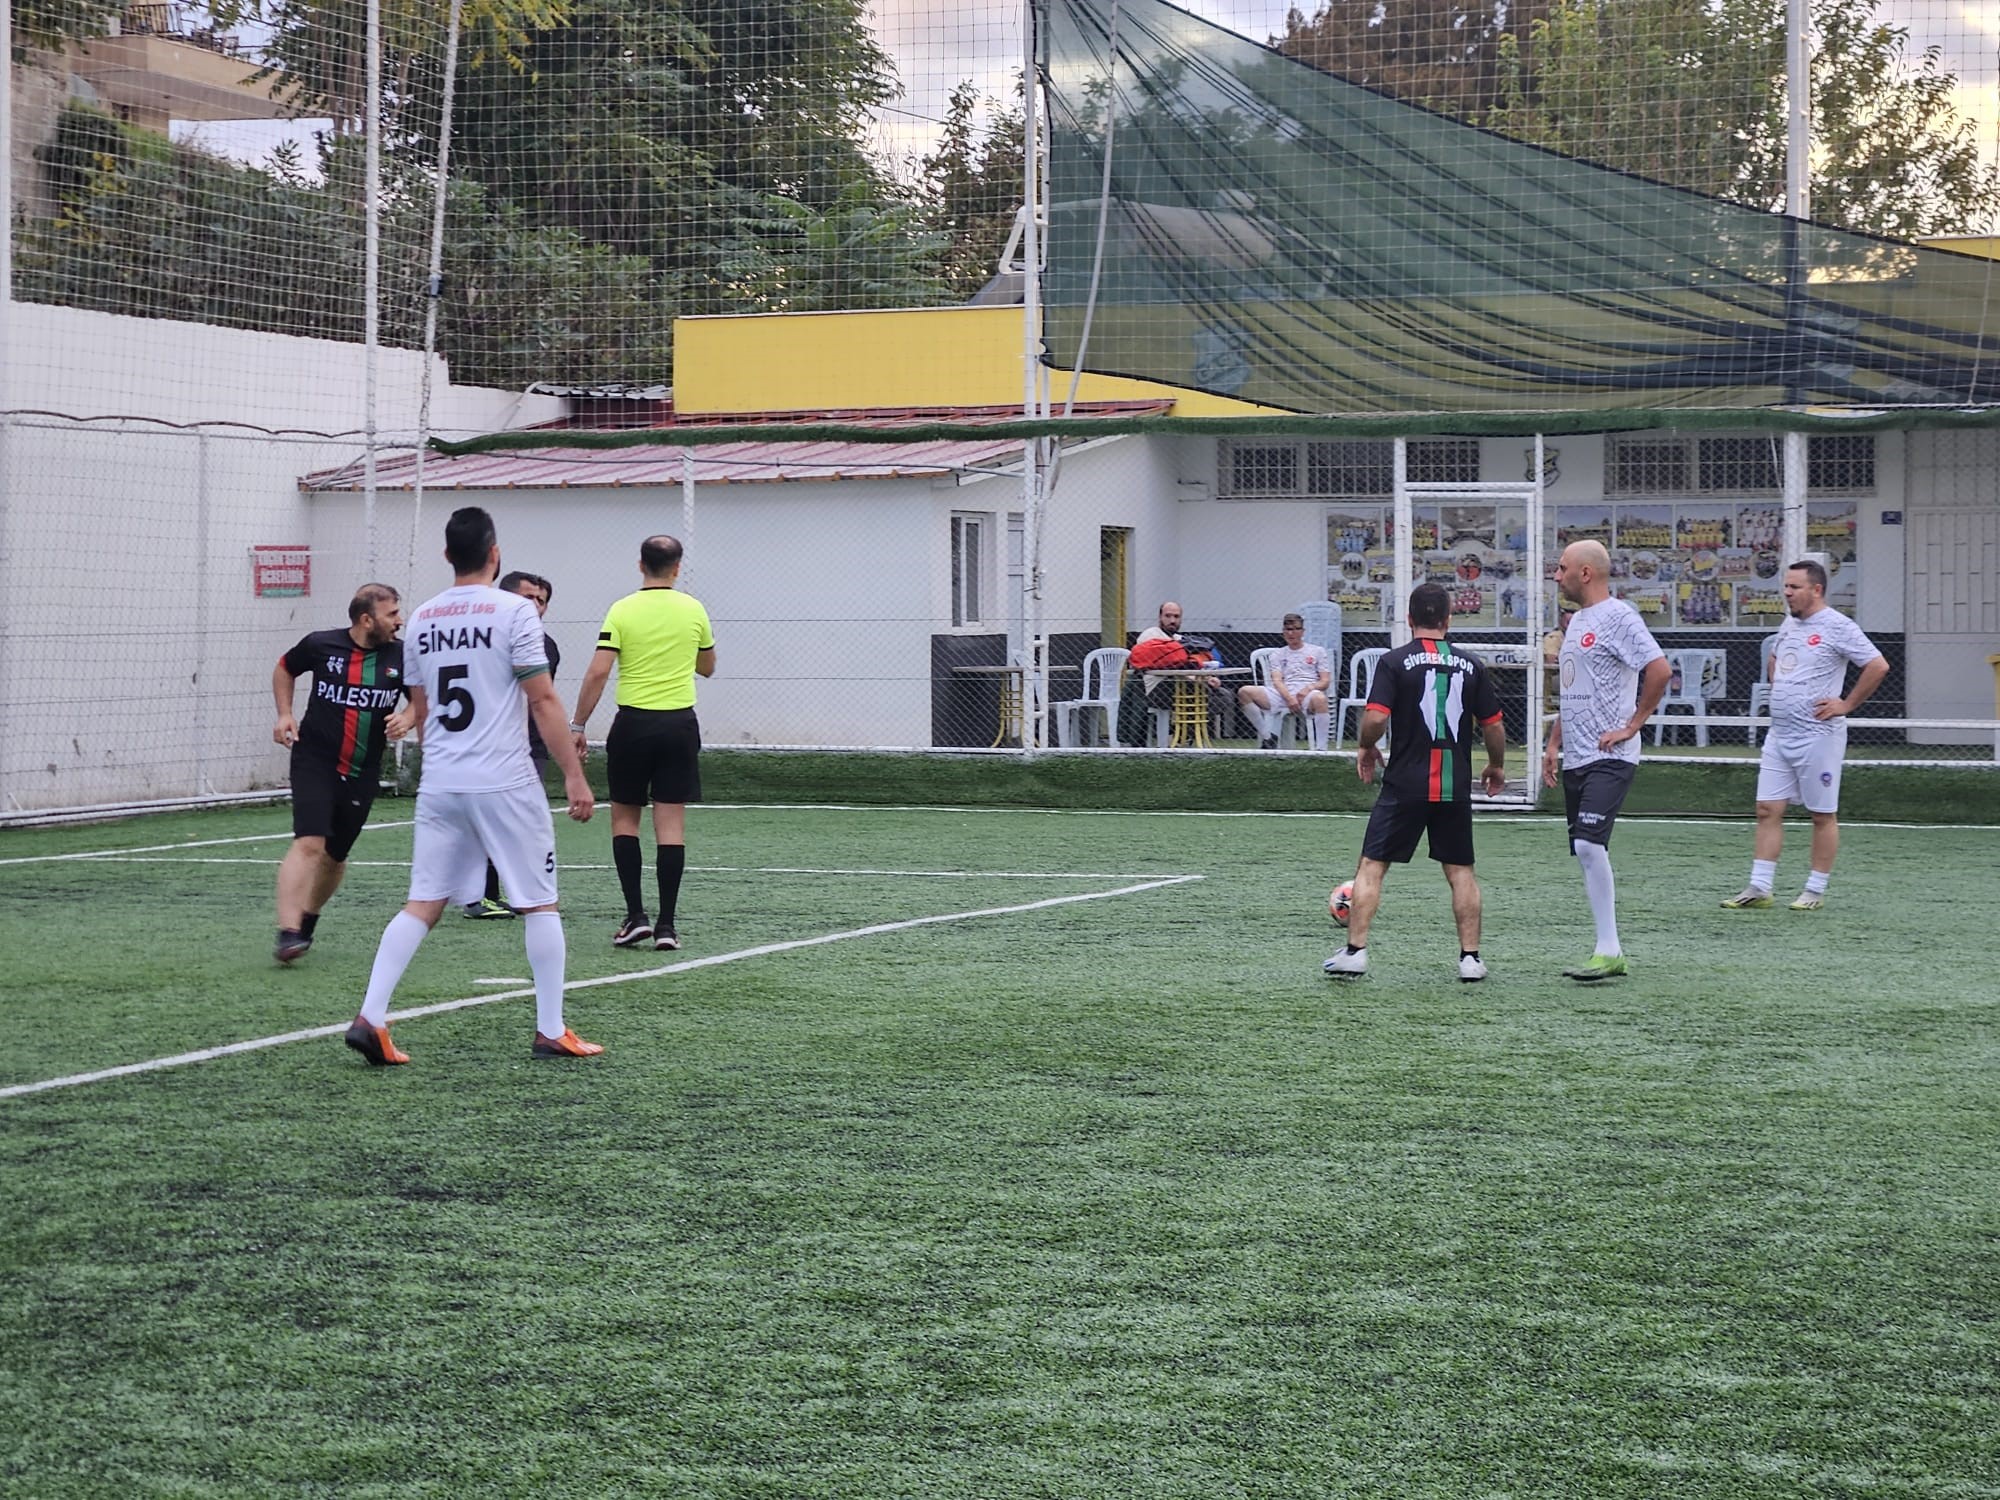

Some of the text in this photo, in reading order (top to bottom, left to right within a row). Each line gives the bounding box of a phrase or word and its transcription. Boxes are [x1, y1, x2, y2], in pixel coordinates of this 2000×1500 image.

[418, 623, 493, 655] SİNAN
[1403, 651, 1446, 671] SİVEREK
[1447, 655, 1474, 675] SPOR
[317, 680, 399, 708] PALESTINE
[437, 664, 475, 732] 5
[545, 851, 555, 874] 5
